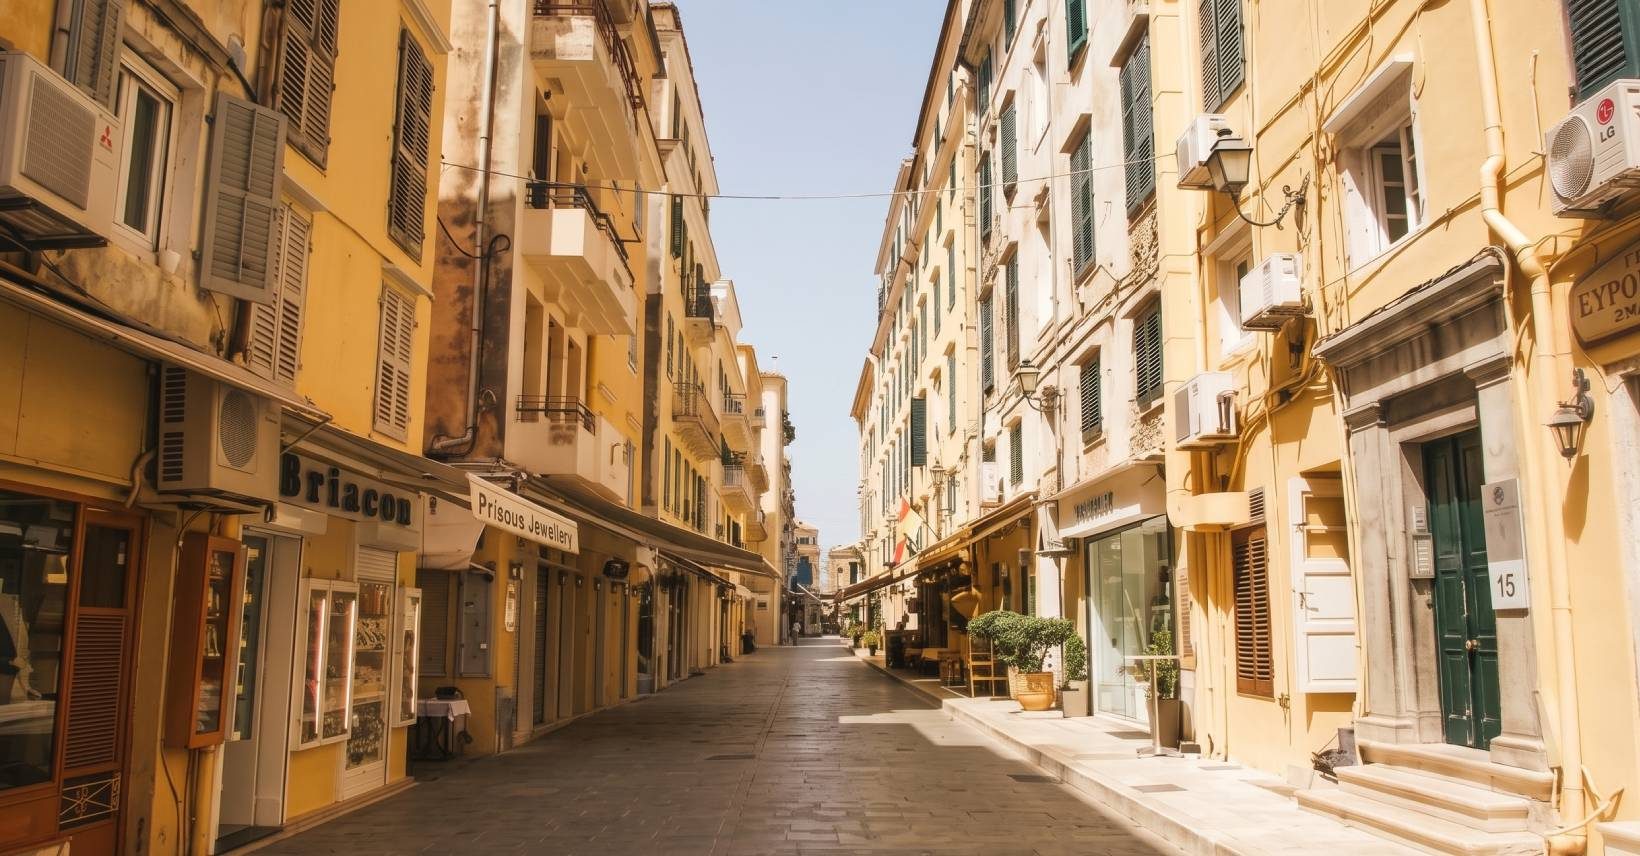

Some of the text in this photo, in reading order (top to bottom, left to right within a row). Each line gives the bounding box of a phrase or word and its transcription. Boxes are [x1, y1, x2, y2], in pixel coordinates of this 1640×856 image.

[1600, 125, 1615, 143] LG
[1577, 269, 1640, 318] ΕΥΡΟ
[280, 453, 411, 526] Briacon
[479, 492, 525, 530] Prisous
[528, 514, 572, 550] Jewellery
[1497, 573, 1516, 598] 15
